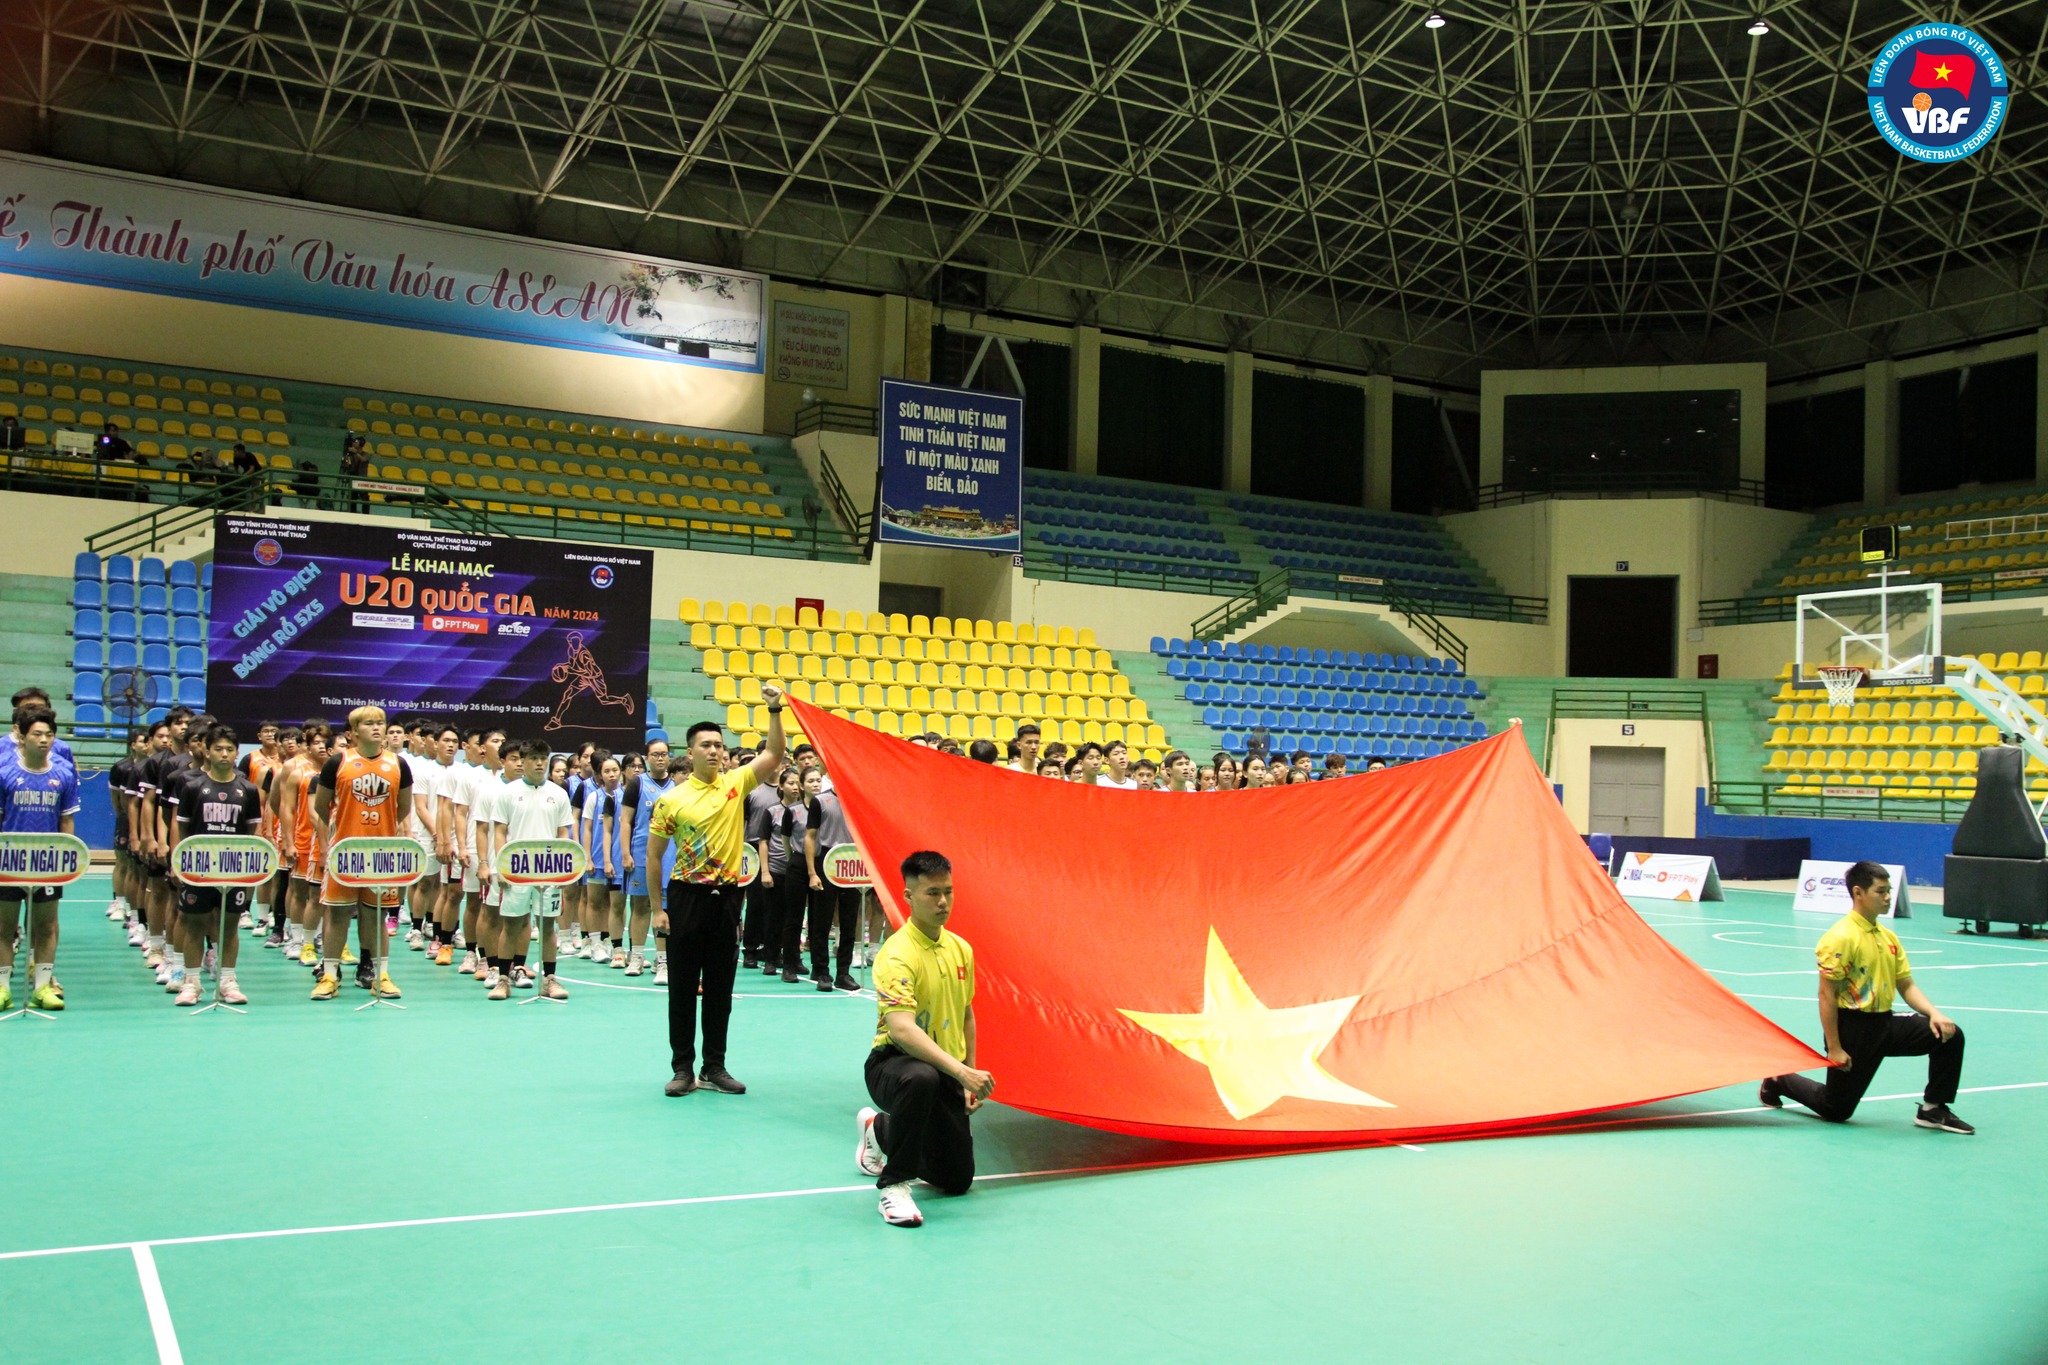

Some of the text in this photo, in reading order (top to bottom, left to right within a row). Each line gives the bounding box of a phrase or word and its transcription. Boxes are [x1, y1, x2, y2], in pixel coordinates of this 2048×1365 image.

[51, 200, 192, 264] Thành
[201, 229, 286, 279] phố
[290, 239, 379, 292] Văn
[387, 253, 457, 302] hóa
[466, 267, 634, 328] ASEAN
[899, 400, 1007, 430] SỨC MẠNH VIỆT NAM
[899, 425, 1006, 453] TINH THẦN VIỆT NAM
[905, 447, 1000, 475] VÌ MỘT MÀU XANH
[926, 471, 979, 495] BIỂN, ĐẢO
[392, 552, 495, 580] LỄ KHAI MẠC
[233, 607, 268, 638] GIẢI
[283, 561, 322, 596] ĐỊCH
[339, 572, 599, 621] U20 QUỐC GIA NĂM 2024
[444, 620, 480, 631] FPT Play
[232, 639, 277, 679] BÓNG
[272, 616, 298, 646] RỔ
[321, 696, 342, 705] Thừa
[343, 698, 366, 706] Thiên
[399, 701, 419, 710] ngày
[432, 701, 448, 709] đến
[449, 703, 468, 712] ngày
[481, 703, 505, 713] tháng
[506, 704, 511, 712] 9
[530, 706, 550, 714] 2024
[1624, 726, 1633, 735] 5
[14, 787, 40, 806] QUẢNG
[352, 772, 392, 798] BRVT
[360, 810, 380, 826] 29
[30, 846, 58, 872] NGÃI
[62, 850, 78, 873] PB
[181, 846, 192, 872] BÀ
[196, 851, 210, 878] RỊA
[220, 847, 242, 873] VŨNG
[245, 847, 261, 873] TÀU
[264, 852, 269, 873] 2
[338, 848, 348, 873] BÀ
[351, 852, 364, 878] RỊA
[373, 848, 394, 873] VŨNG
[397, 848, 412, 873] TÀU
[414, 852, 418, 873] 1
[511, 846, 572, 874] ĐÀ NẴNG
[235, 891, 245, 906] 9
[382, 888, 398, 900] 29
